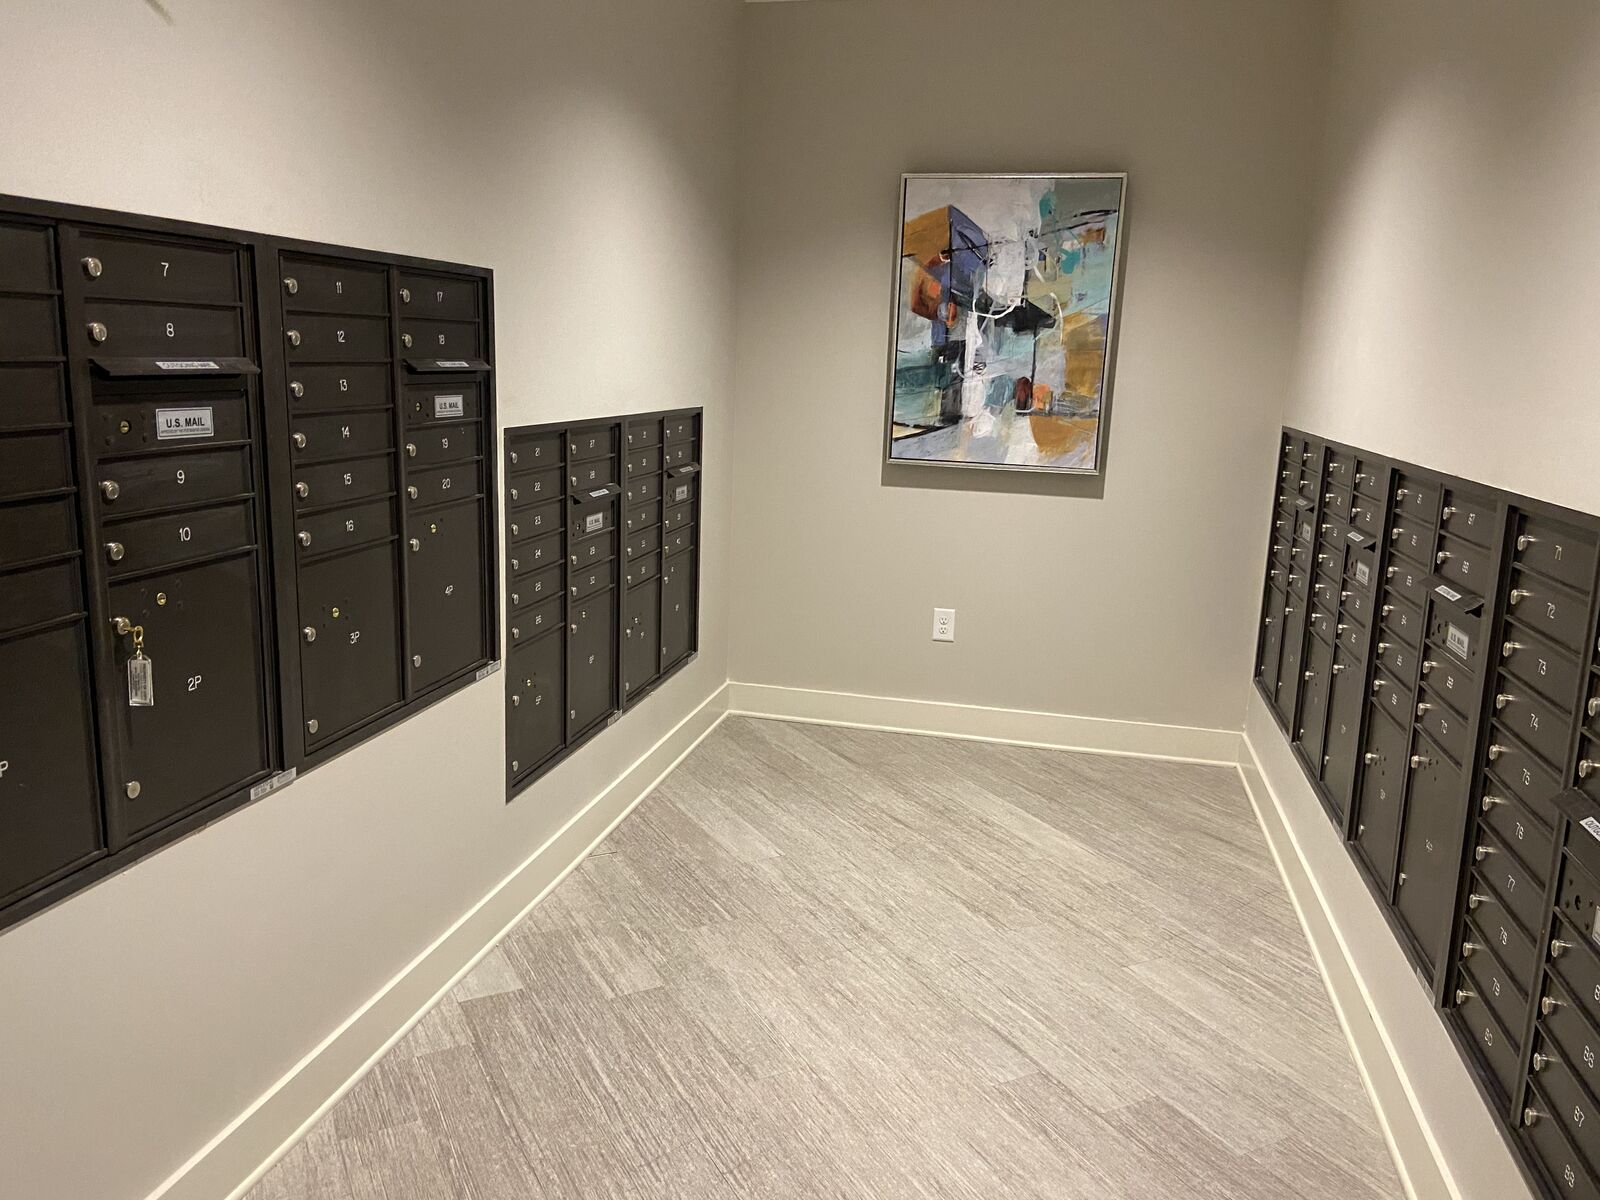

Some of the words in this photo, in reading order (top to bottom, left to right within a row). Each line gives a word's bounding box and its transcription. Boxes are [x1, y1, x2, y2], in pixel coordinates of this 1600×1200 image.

[160, 261, 170, 277] 7
[335, 281, 343, 294] 11
[436, 291, 444, 303] 17
[166, 322, 175, 338] 8
[336, 330, 346, 343] 12
[438, 334, 446, 345] 18
[339, 378, 348, 392] 13
[439, 402, 448, 410] U.S.
[448, 401, 459, 409] MAIL
[166, 418, 184, 428] U.S.
[184, 417, 205, 427] MAIL
[341, 425, 350, 439] 14
[441, 437, 449, 449] 19
[176, 469, 185, 484] 9
[343, 472, 352, 485] 15
[441, 478, 451, 490] 20
[534, 481, 541, 492] 22
[345, 519, 354, 532] 16
[534, 515, 542, 526] 23
[178, 526, 191, 542] 10
[1554, 544, 1563, 561] 71
[1546, 602, 1556, 619] 72
[349, 630, 360, 645] 3P
[1538, 658, 1547, 676] 73
[187, 674, 202, 692] 2P
[1530, 713, 1539, 731] 74
[0, 759, 9, 779] P
[1522, 768, 1531, 786] 75
[1515, 821, 1524, 840] 76
[1507, 874, 1516, 893] 77
[1499, 926, 1508, 946] 78
[1492, 977, 1501, 997] 79
[1594, 984, 1600, 1004] 8
[1484, 1027, 1493, 1047] 80
[1583, 1045, 1595, 1069] 86
[1573, 1105, 1585, 1128] 87
[1563, 1164, 1575, 1188] 88
